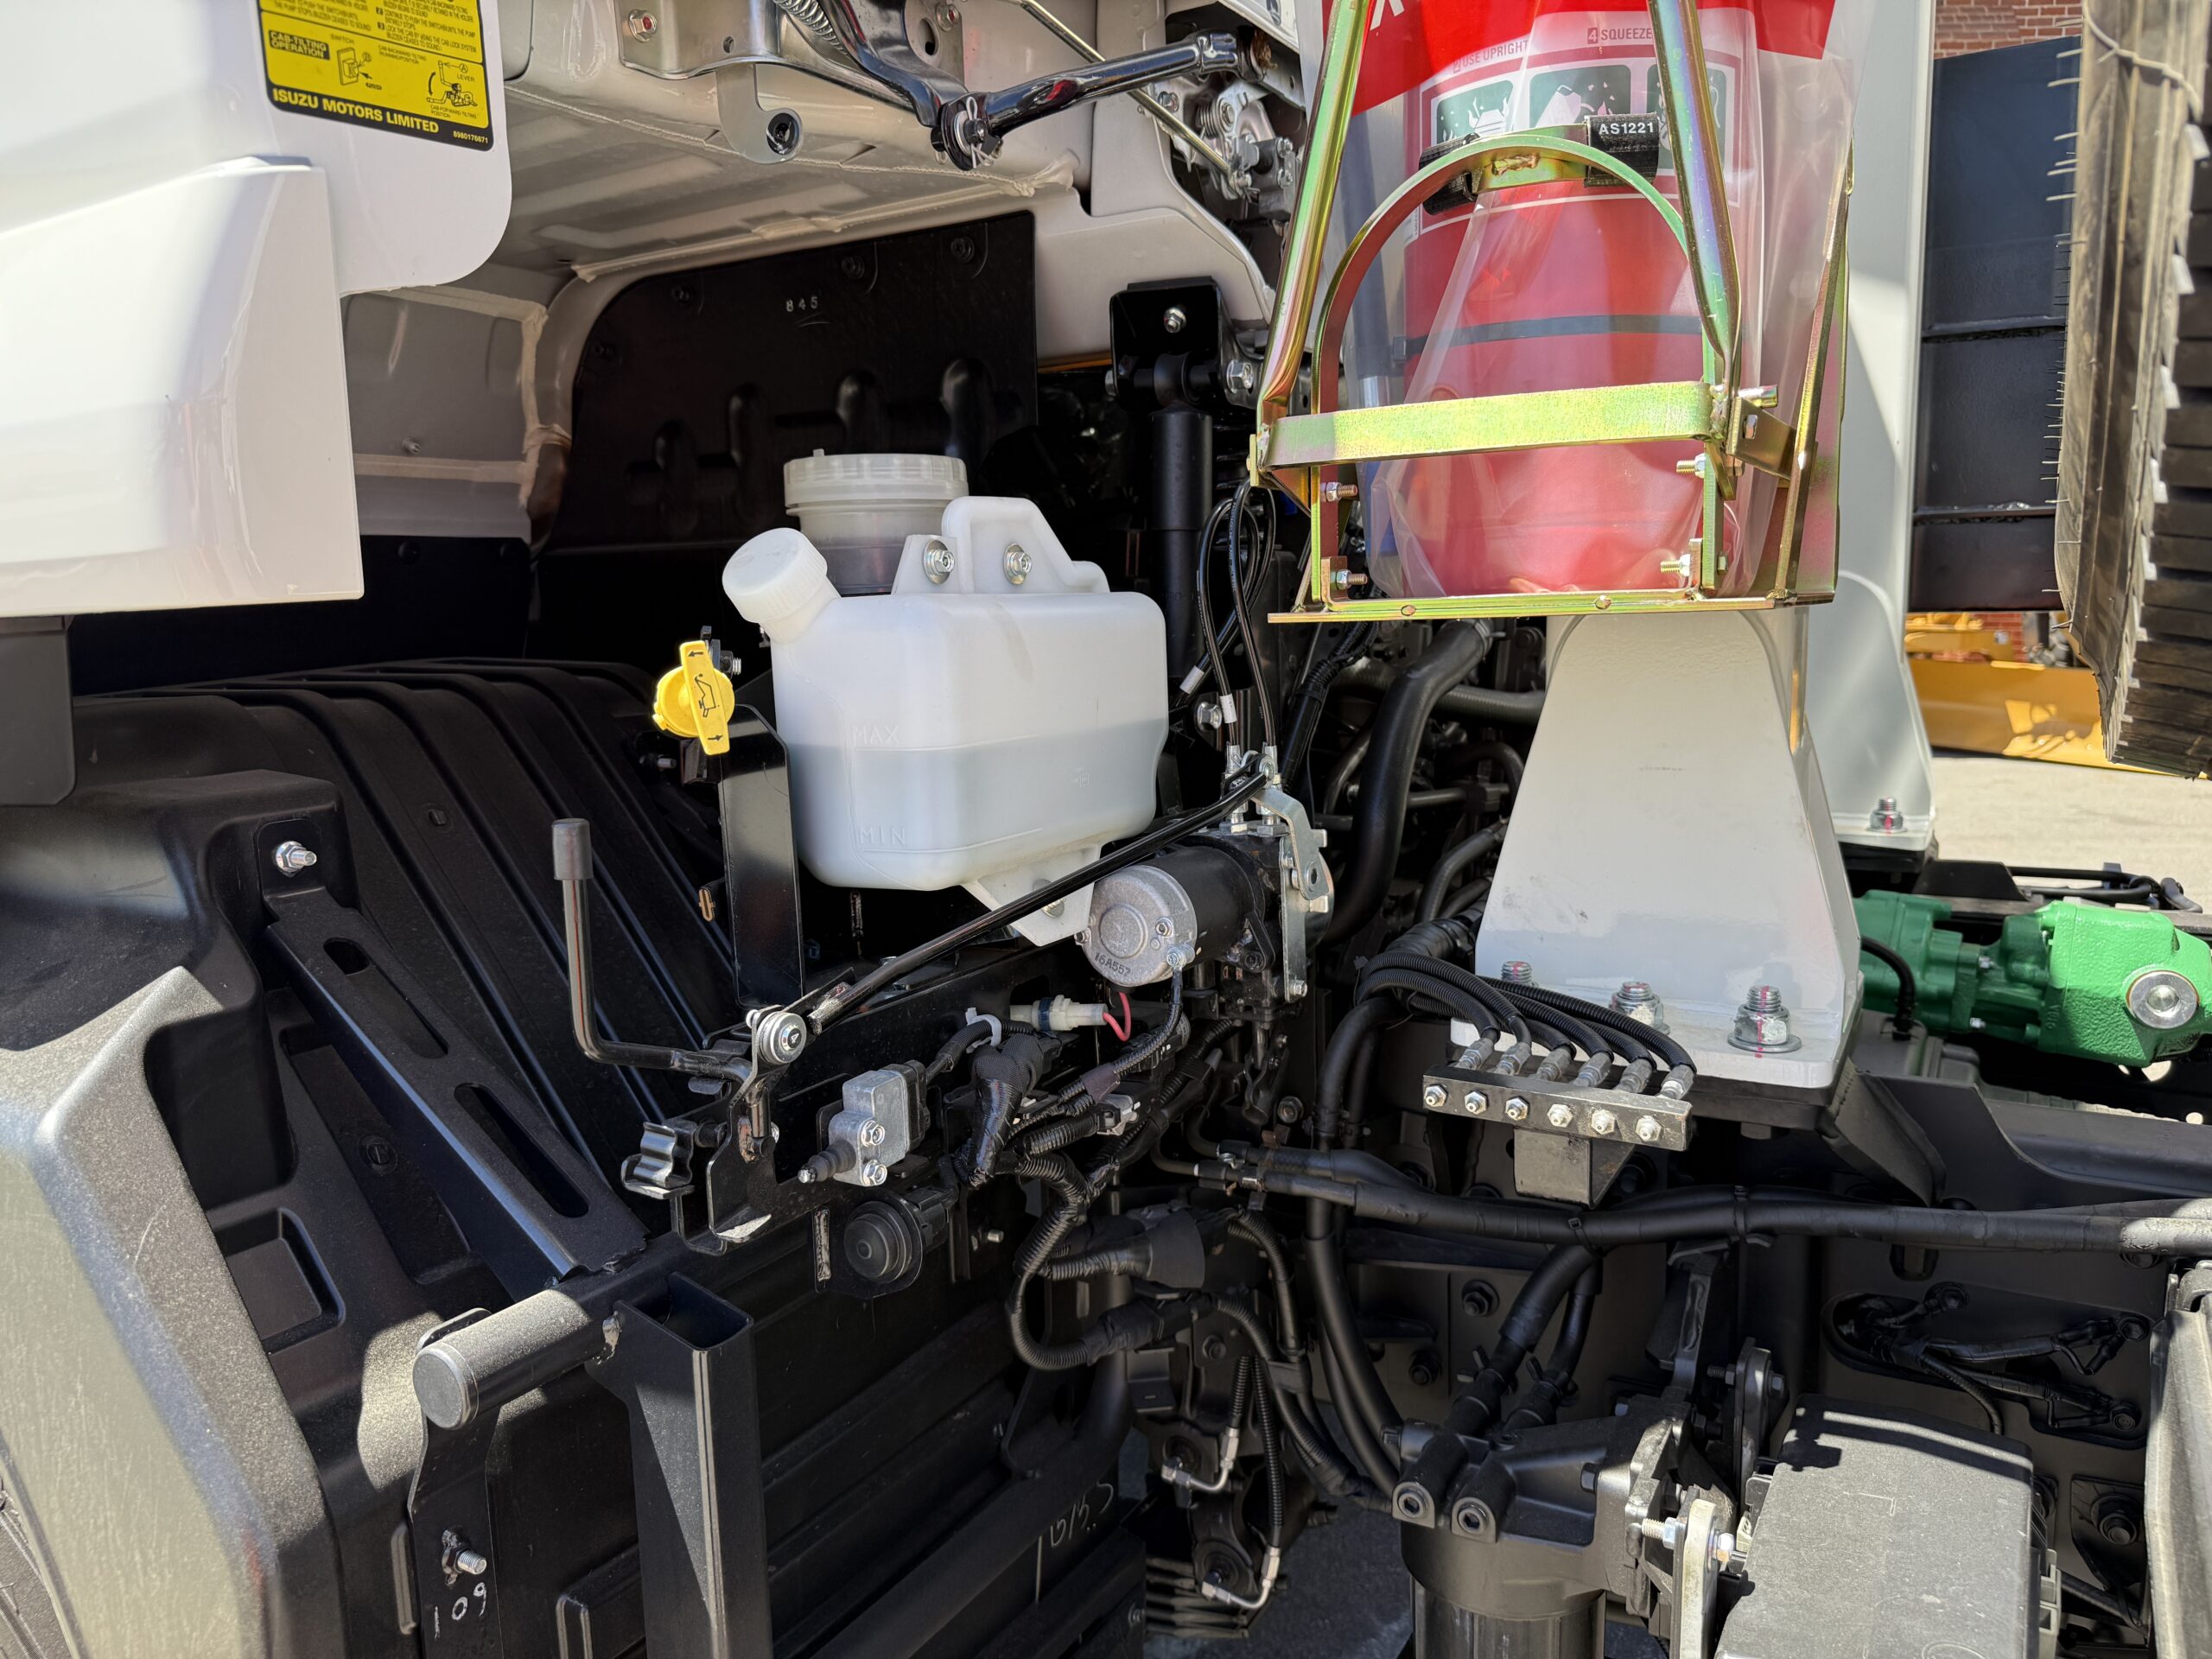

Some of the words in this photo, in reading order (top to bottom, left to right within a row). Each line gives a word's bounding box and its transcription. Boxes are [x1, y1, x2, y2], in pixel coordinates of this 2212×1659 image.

[270, 31, 327, 51] CAB-TILTING
[1588, 28, 1598, 44] 4
[1601, 28, 1652, 41] SQUEEZE
[271, 40, 324, 58] OPERATION
[1463, 54, 1480, 68] USE
[1483, 40, 1529, 61] UPRIGHT
[273, 87, 319, 109] ISUZU
[322, 98, 384, 122] MOTORS
[386, 111, 439, 133] LIMITED
[1599, 122, 1655, 135] AS1221
[852, 724, 899, 746] MAX
[859, 827, 906, 846] MIN
